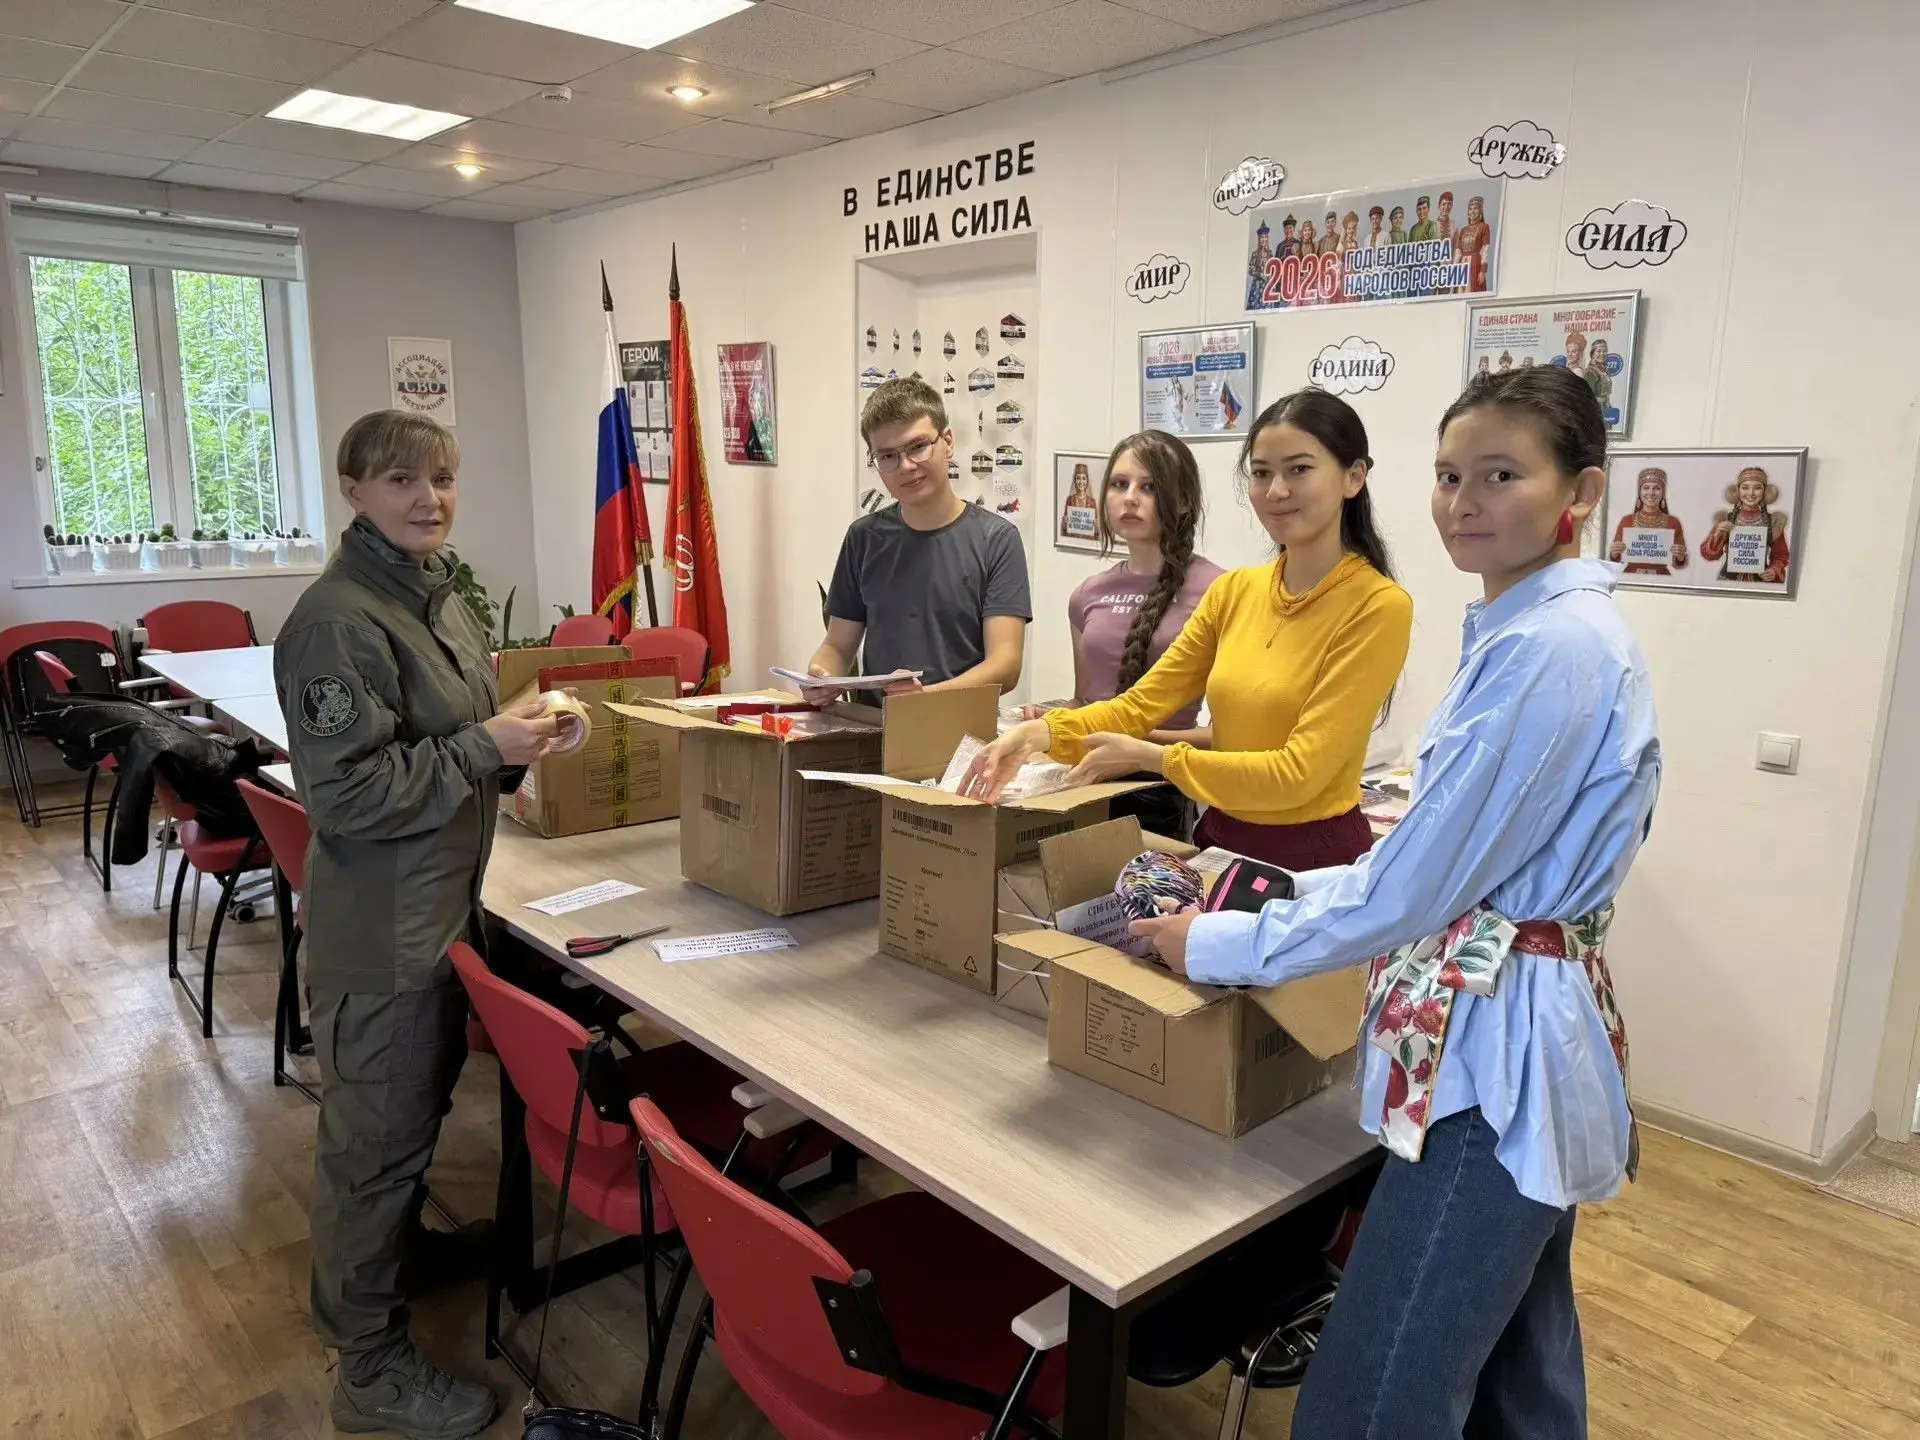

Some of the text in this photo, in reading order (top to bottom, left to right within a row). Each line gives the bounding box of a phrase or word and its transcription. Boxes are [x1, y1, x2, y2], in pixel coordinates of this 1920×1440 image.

[843, 140, 1035, 216] В ЕДИНСТВЕ
[865, 195, 1032, 253] НАША СИЛА
[1578, 222, 1673, 252] СИЛА
[1345, 239, 1451, 272] ГОД ЕДИНСТВА
[1134, 263, 1181, 291] МИР
[1263, 251, 1339, 302] 2026
[1345, 263, 1469, 296] НАРОДОВ РОССИИ
[1479, 313, 1538, 326] ЕДИНАЯ СТРАНА
[1553, 308, 1617, 322] МНОГООБРАЗИЕ
[1564, 320, 1612, 333] НАША СИЛА
[622, 346, 659, 363] ГЕРОИ
[1159, 340, 1180, 355] 2026
[1311, 356, 1389, 379] РОДИНА
[404, 381, 440, 393] СВО
[1100, 594, 1148, 604] CALIFO
[1112, 605, 1132, 614] EST
